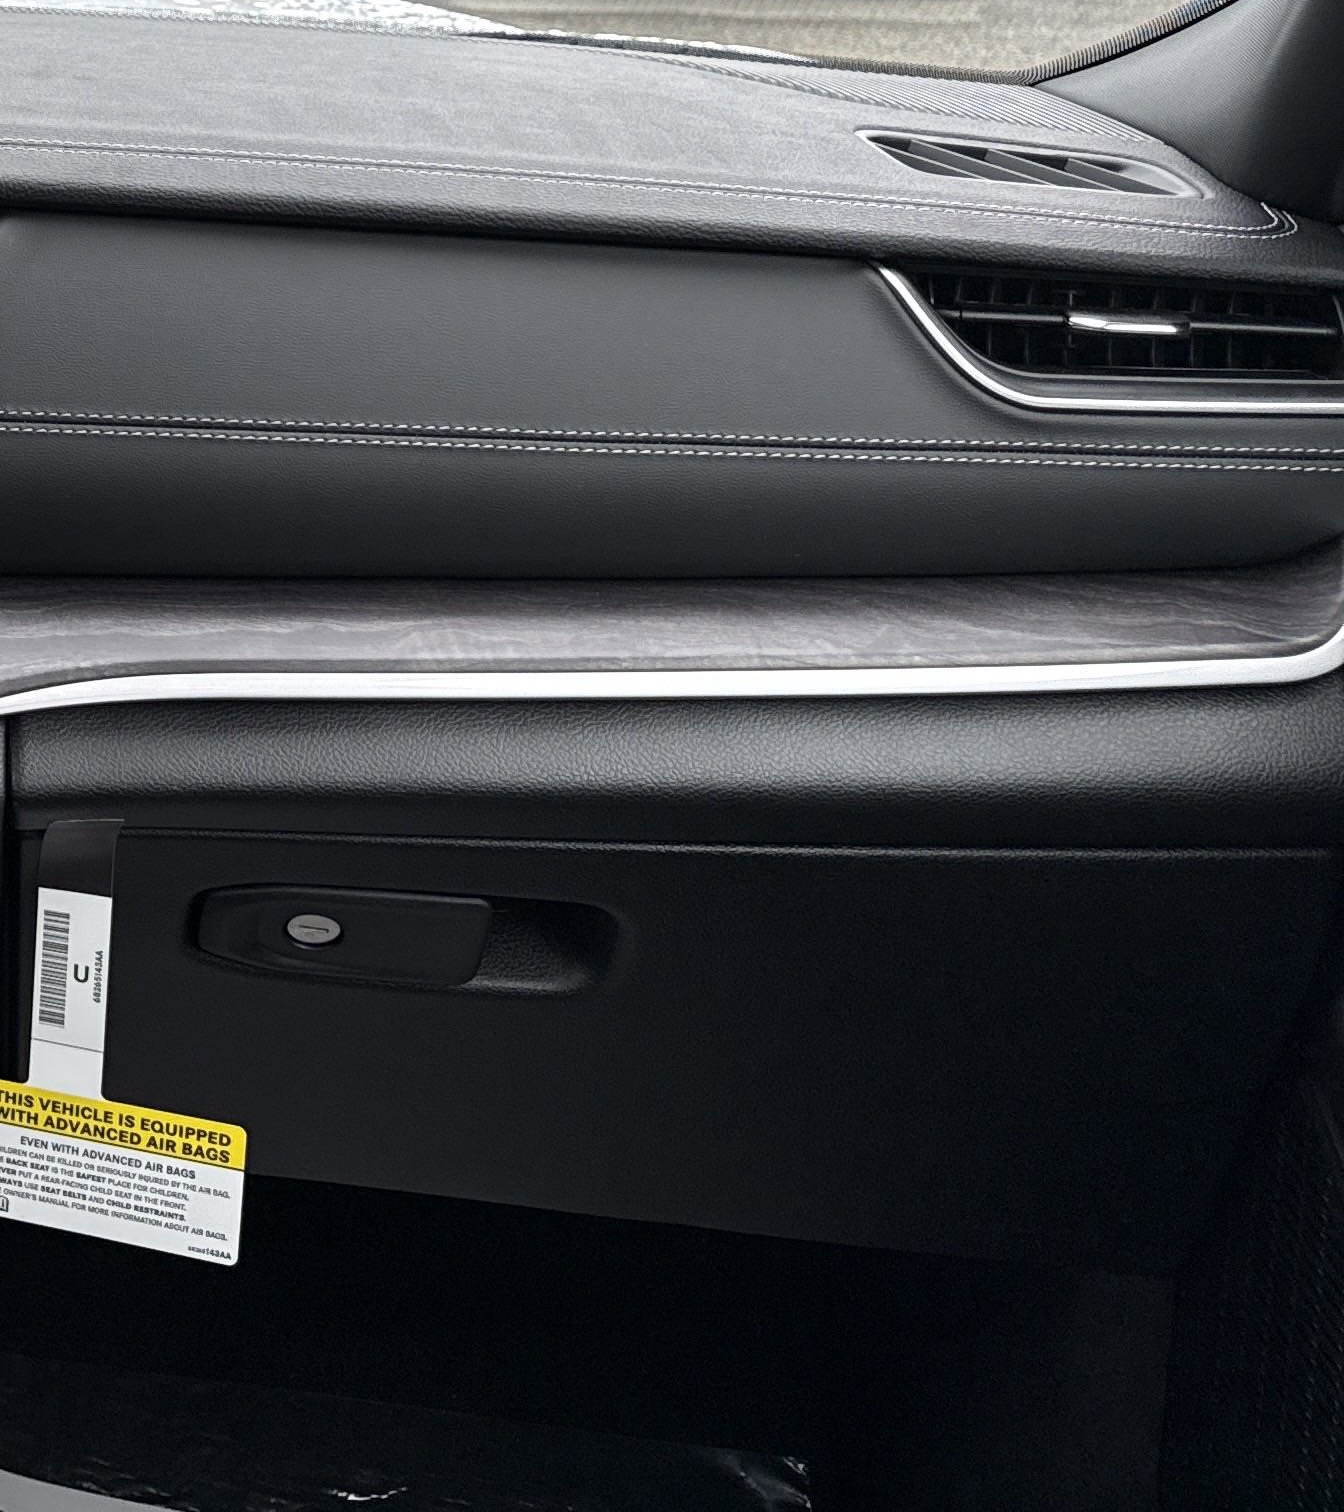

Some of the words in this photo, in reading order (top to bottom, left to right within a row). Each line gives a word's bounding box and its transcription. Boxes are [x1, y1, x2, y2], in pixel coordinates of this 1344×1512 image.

[73, 963, 90, 983] U
[38, 1097, 113, 1125] VEHICLE
[118, 1113, 136, 1129] IS
[140, 1118, 232, 1148] EQUIPPED
[43, 1114, 142, 1146] ADVANCED
[146, 1134, 176, 1154] AIR
[181, 1142, 231, 1164] BAGS
[6, 1157, 28, 1168] BACK
[30, 1162, 50, 1172] SEAT
[60, 1168, 74, 1178] THE
[76, 1171, 106, 1184] SAFEST
[108, 1178, 131, 1189] PLACE
[133, 1182, 148, 1193] FOR
[20, 1135, 48, 1150] EVEN
[51, 1142, 80, 1156] WITH
[82, 1148, 142, 1169] ADVANCED
[144, 1161, 164, 1173] AIR
[166, 1165, 196, 1180] BAGS
[29, 1152, 44, 1161] CAN
[46, 1154, 56, 1163] BE
[58, 1157, 82, 1168] KILLED
[84, 1163, 95, 1171] OR
[97, 1165, 137, 1179] SERIOUSLY
[138, 1173, 169, 1186] INJURED
[182, 1182, 196, 1192] THE
[198, 1186, 211, 1195] AIR
[3, 1188, 37, 1201] OWNER'S
[38, 1194, 69, 1208] MANUAL
[71, 1201, 86, 1211] FOR
[88, 1204, 109, 1216] MORE
[111, 1209, 162, 1227] INFORMATION
[164, 1222, 189, 1233] ABOUT
[191, 1228, 204, 1236] AIR
[18, 1170, 32, 1179] PUT
[90, 1185, 113, 1195] CHILD
[114, 1190, 132, 1199] SEAT
[144, 1196, 159, 1205] THE
[160, 1199, 187, 1211] FRONT.
[24, 1181, 39, 1191] USE
[41, 1185, 61, 1196] SEAT
[63, 1189, 87, 1200] BELTS
[88, 1194, 105, 1205] AND
[106, 1199, 132, 1210] CHILD
[134, 1204, 186, 1222] RESTRAINTS.
